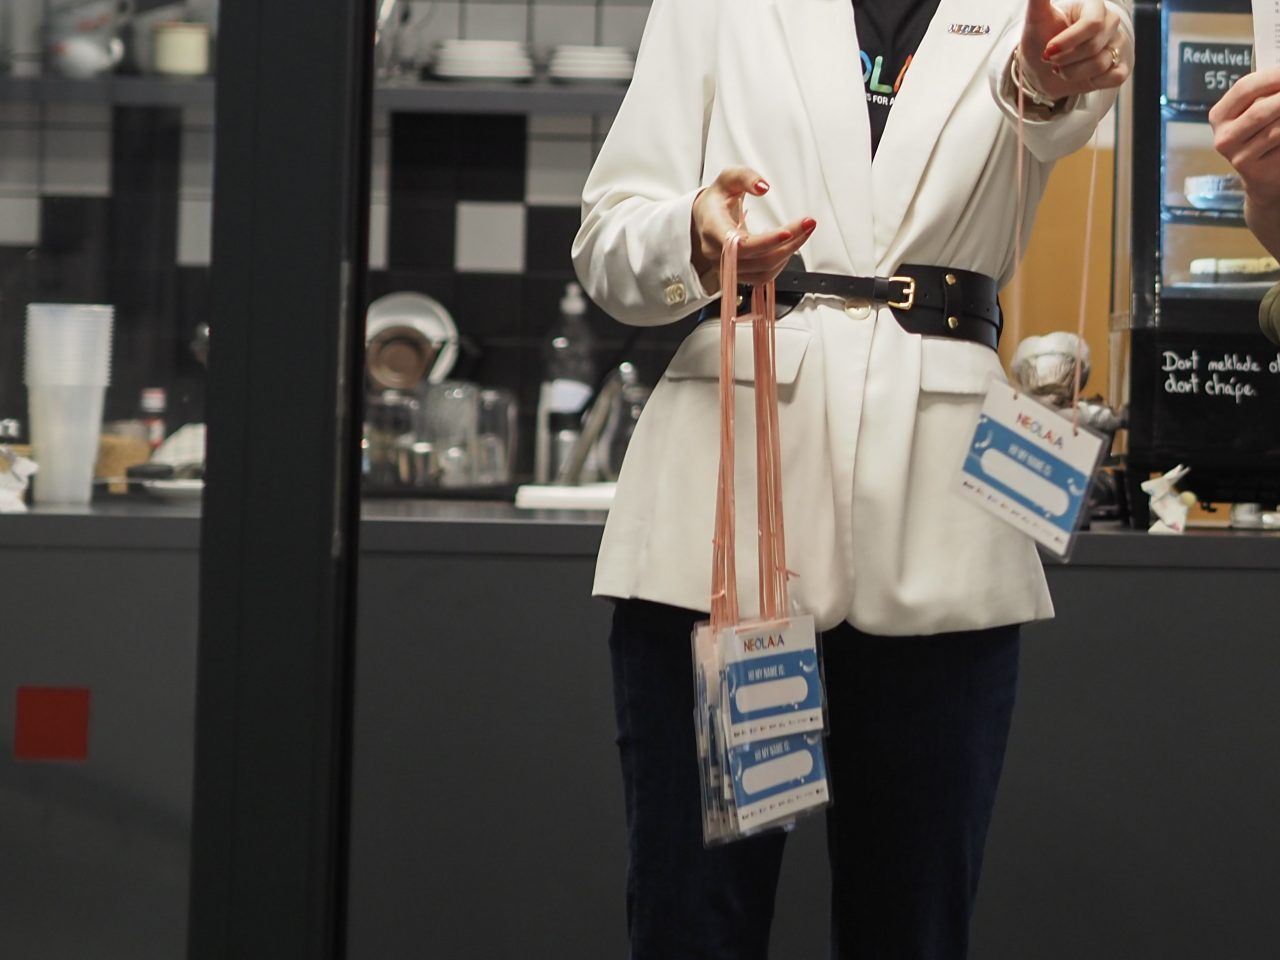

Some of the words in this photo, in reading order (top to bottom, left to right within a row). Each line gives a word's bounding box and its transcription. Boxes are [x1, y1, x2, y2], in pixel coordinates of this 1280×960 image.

[872, 94, 889, 106] FOR
[1161, 349, 1200, 372] Dort
[1164, 372, 1200, 393] dort
